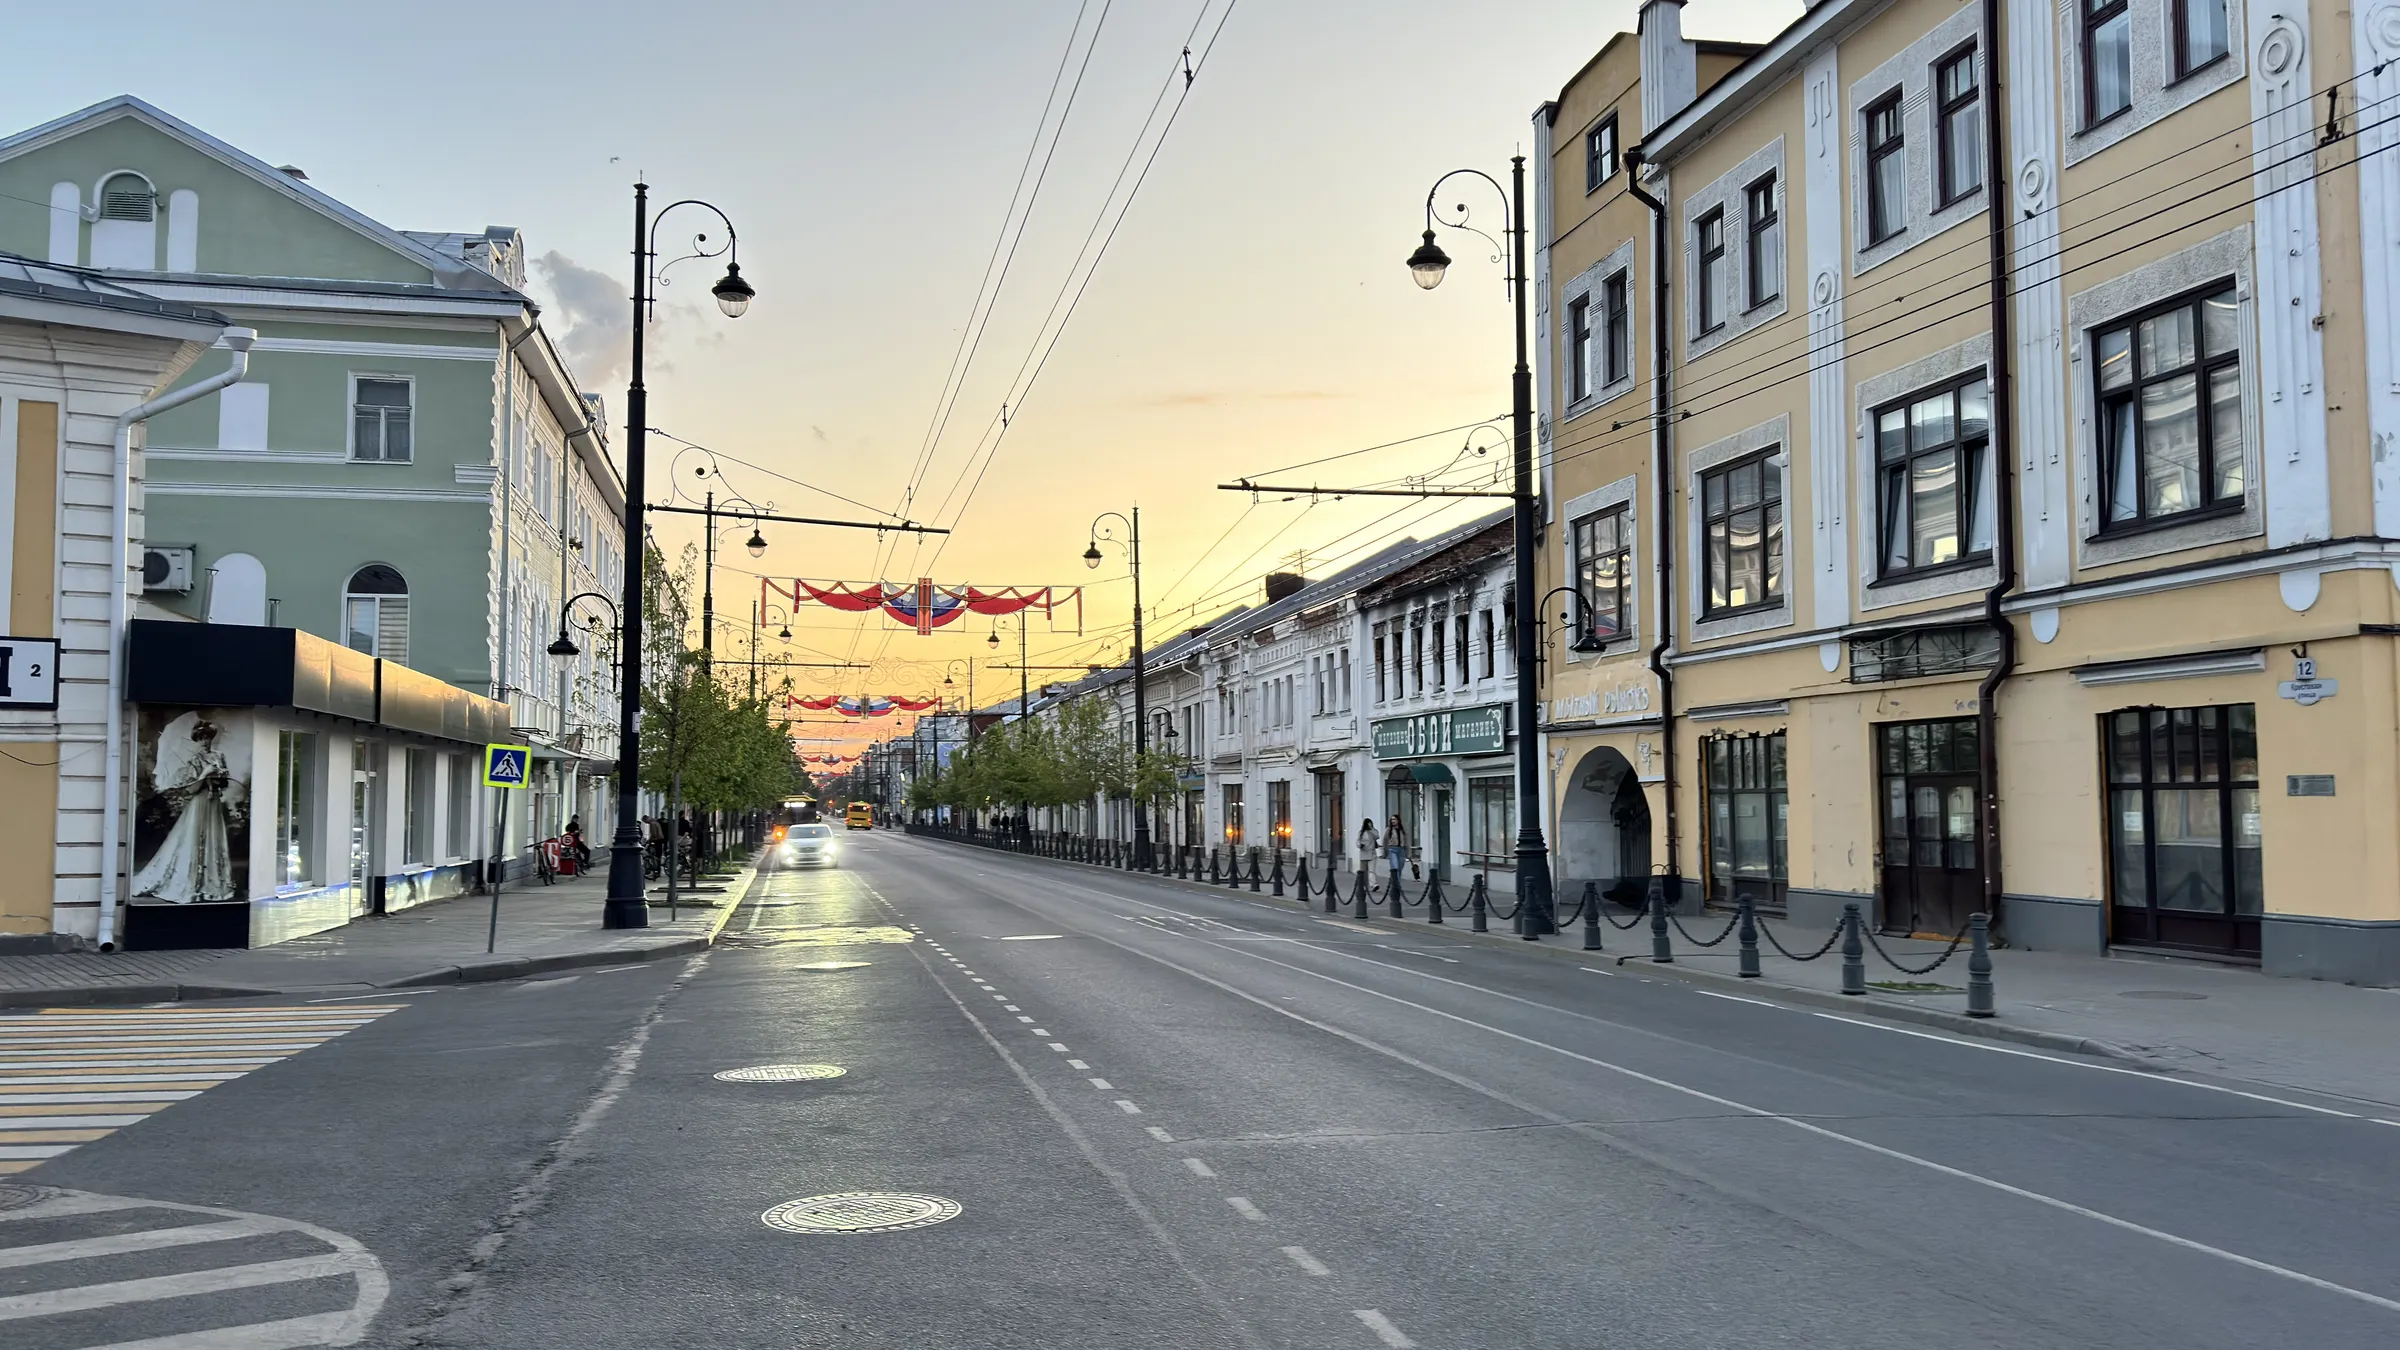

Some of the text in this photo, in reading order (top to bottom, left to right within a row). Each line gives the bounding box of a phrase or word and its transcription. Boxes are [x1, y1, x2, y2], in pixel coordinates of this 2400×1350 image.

[30, 663, 42, 677] 2
[2297, 661, 2312, 676] 12
[1407, 713, 1452, 755] ОБОИ
